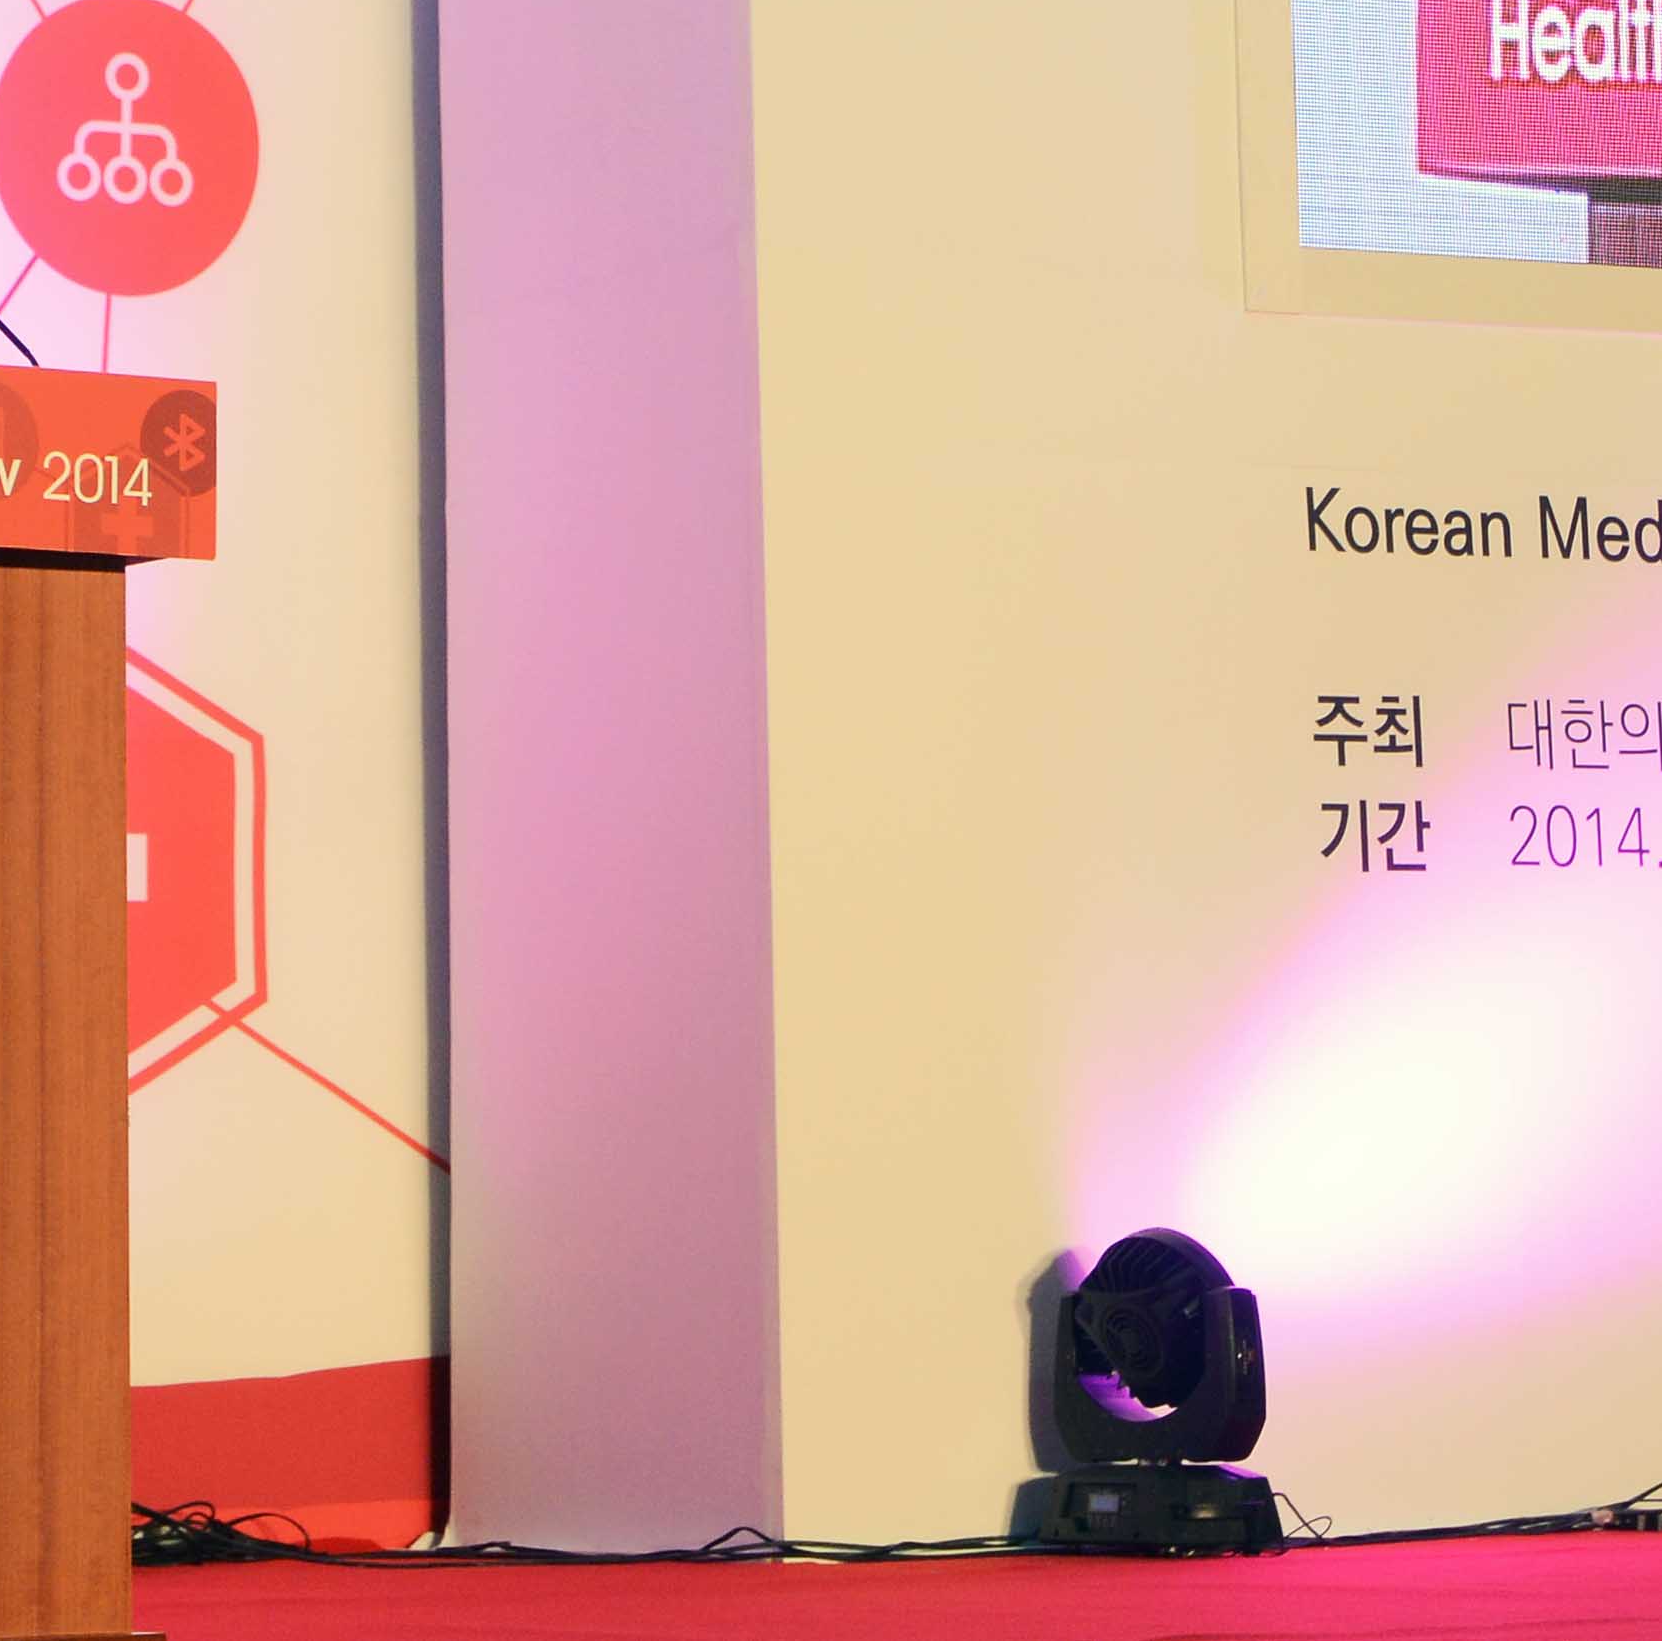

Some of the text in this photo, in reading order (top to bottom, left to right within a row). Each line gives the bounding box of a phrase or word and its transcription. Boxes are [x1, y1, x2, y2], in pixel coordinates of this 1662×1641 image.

[42, 450, 153, 507] 2014
[1306, 487, 1512, 559] Korean
[1313, 694, 1424, 769] 주최
[1321, 799, 1432, 873] 기간
